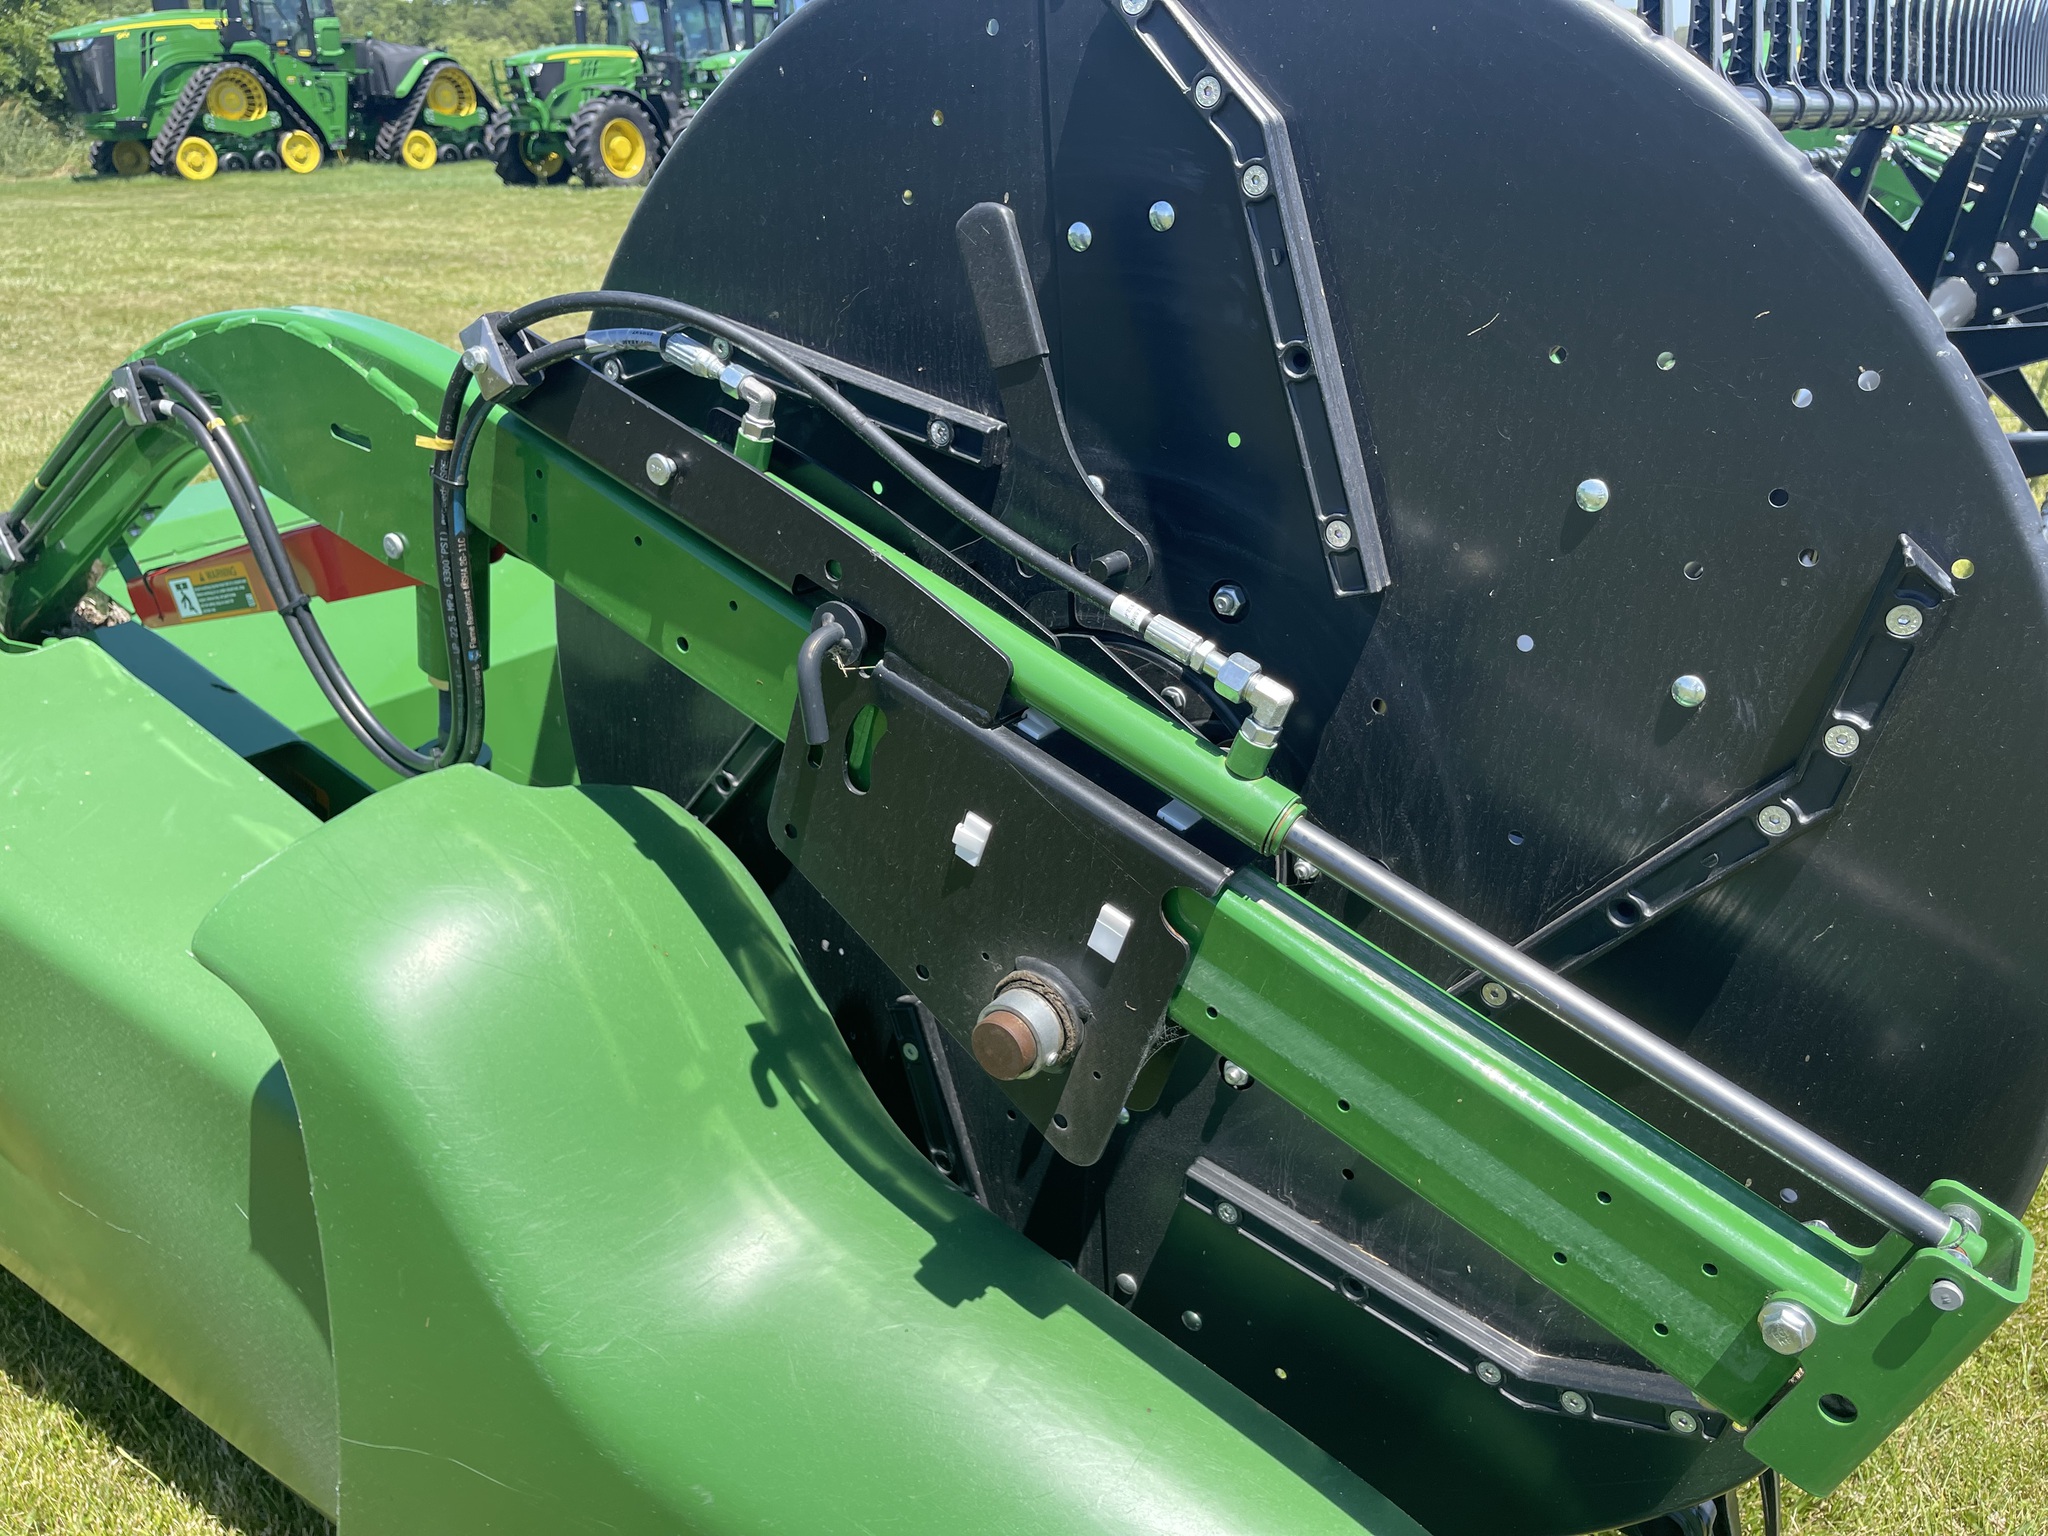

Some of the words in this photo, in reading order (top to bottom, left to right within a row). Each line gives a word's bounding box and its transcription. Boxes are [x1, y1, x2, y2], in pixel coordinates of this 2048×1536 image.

[440, 458, 448, 480] SAE
[440, 531, 449, 555] PSI)
[205, 566, 237, 578] WARNING
[442, 559, 452, 587] (3300
[445, 593, 455, 612] MPa
[464, 590, 474, 626] Resistant
[448, 615, 458, 638] 22.5
[469, 625, 477, 649] Flame
